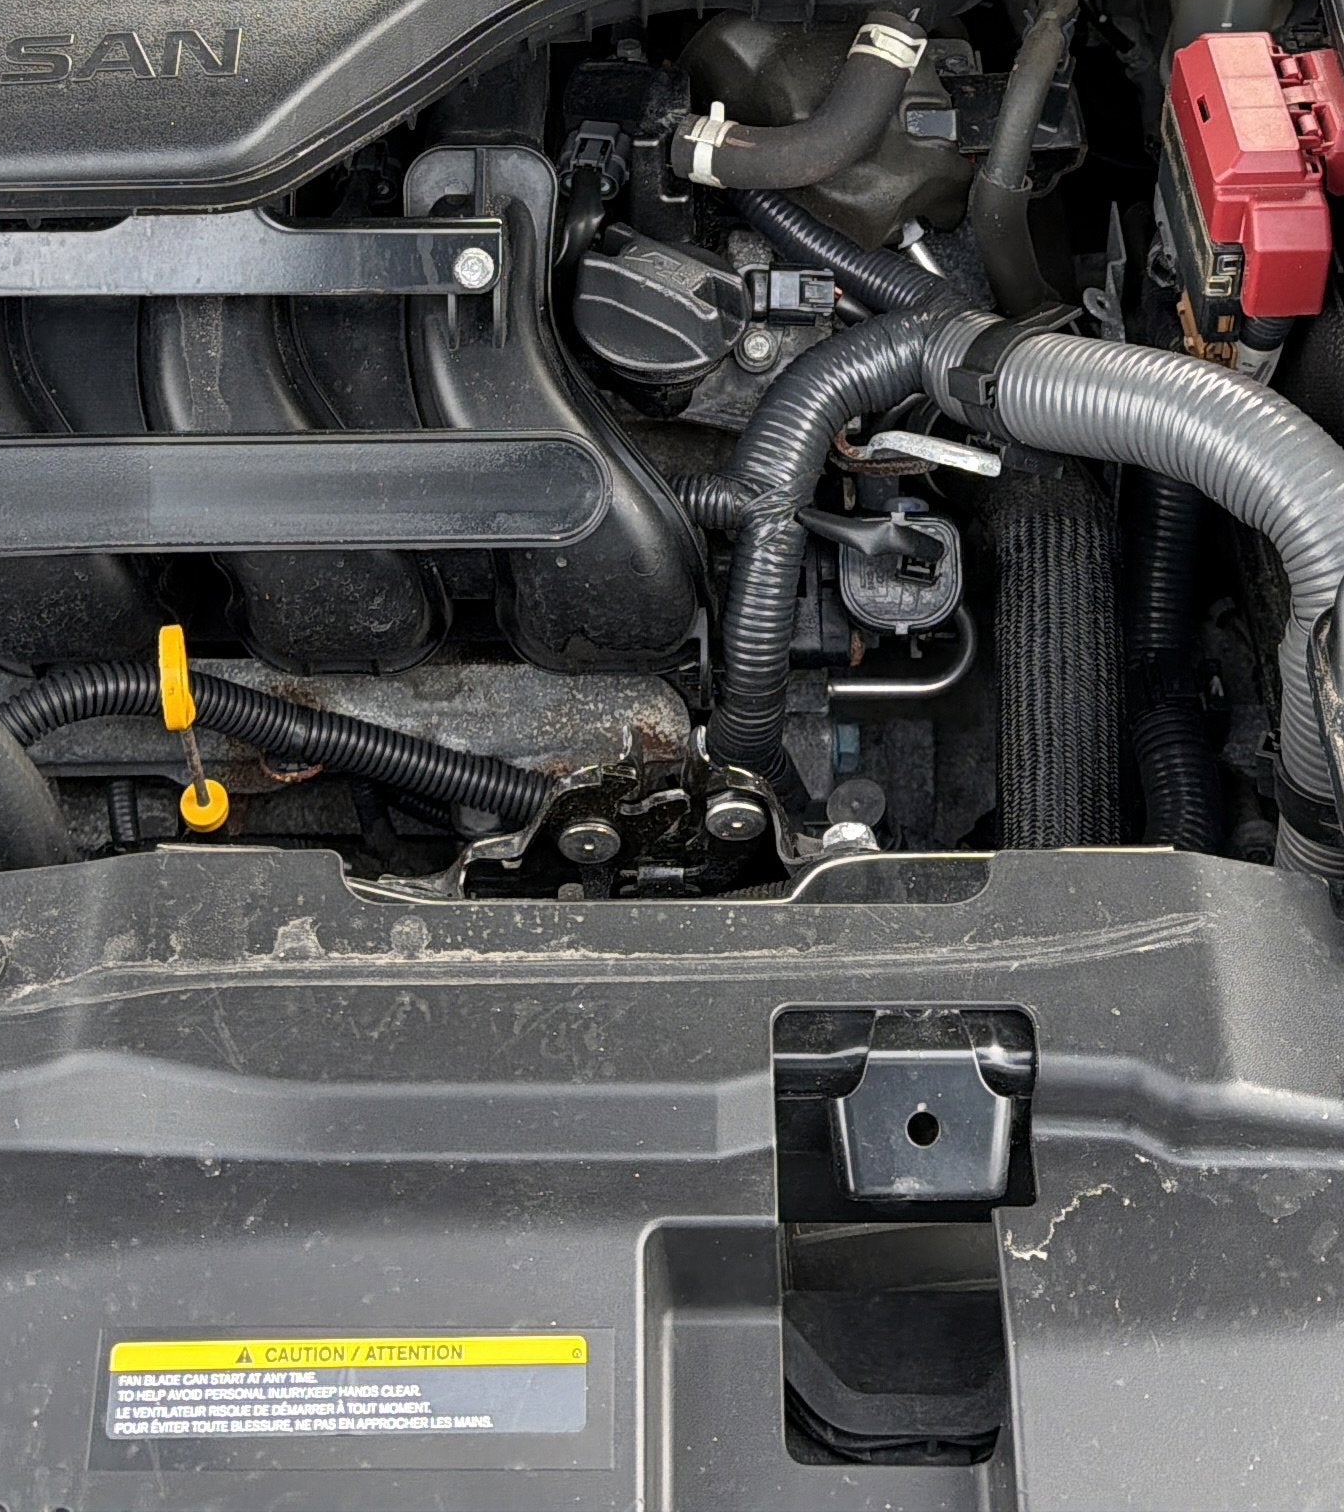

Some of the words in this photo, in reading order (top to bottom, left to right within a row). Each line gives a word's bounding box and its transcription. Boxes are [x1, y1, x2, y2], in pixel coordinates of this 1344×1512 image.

[265, 1345, 345, 1363] CAUTION
[350, 1345, 359, 1362] /
[364, 1343, 463, 1362] ATTENTION
[118, 1375, 142, 1386] FAN
[143, 1374, 181, 1386] BLADE
[183, 1374, 208, 1385] CAN
[210, 1373, 245, 1385] START
[246, 1373, 261, 1384] AT
[263, 1372, 287, 1384] ANY
[289, 1372, 318, 1383] TIME.
[118, 1390, 134, 1402] TO
[136, 1389, 167, 1401] HELP
[167, 1389, 202, 1401] AVOID
[205, 1388, 265, 1400] PERSONAL
[338, 1385, 379, 1397] HANDS
[380, 1385, 422, 1397] CLEAR.
[116, 1407, 131, 1419] LE
[133, 1405, 206, 1419] VENTILATEUR
[208, 1405, 252, 1417] RISQUE
[254, 1404, 270, 1416] DE
[272, 1401, 335, 1416] DÉMARRER
[336, 1399, 346, 1414] À
[347, 1402, 377, 1414] TOUT
[379, 1402, 432, 1414] MOMENT.
[114, 1422, 148, 1434] POUR
[150, 1419, 189, 1434] ÉVITER
[191, 1421, 229, 1433] TOUTE
[230, 1419, 293, 1433] BLESSURE,
[295, 1419, 313, 1431] NE
[313, 1419, 336, 1431] PAS
[338, 1418, 355, 1430] EN
[356, 1416, 428, 1430] APPROCHER
[430, 1416, 453, 1428] LES
[454, 1415, 494, 1428] MAINS.
